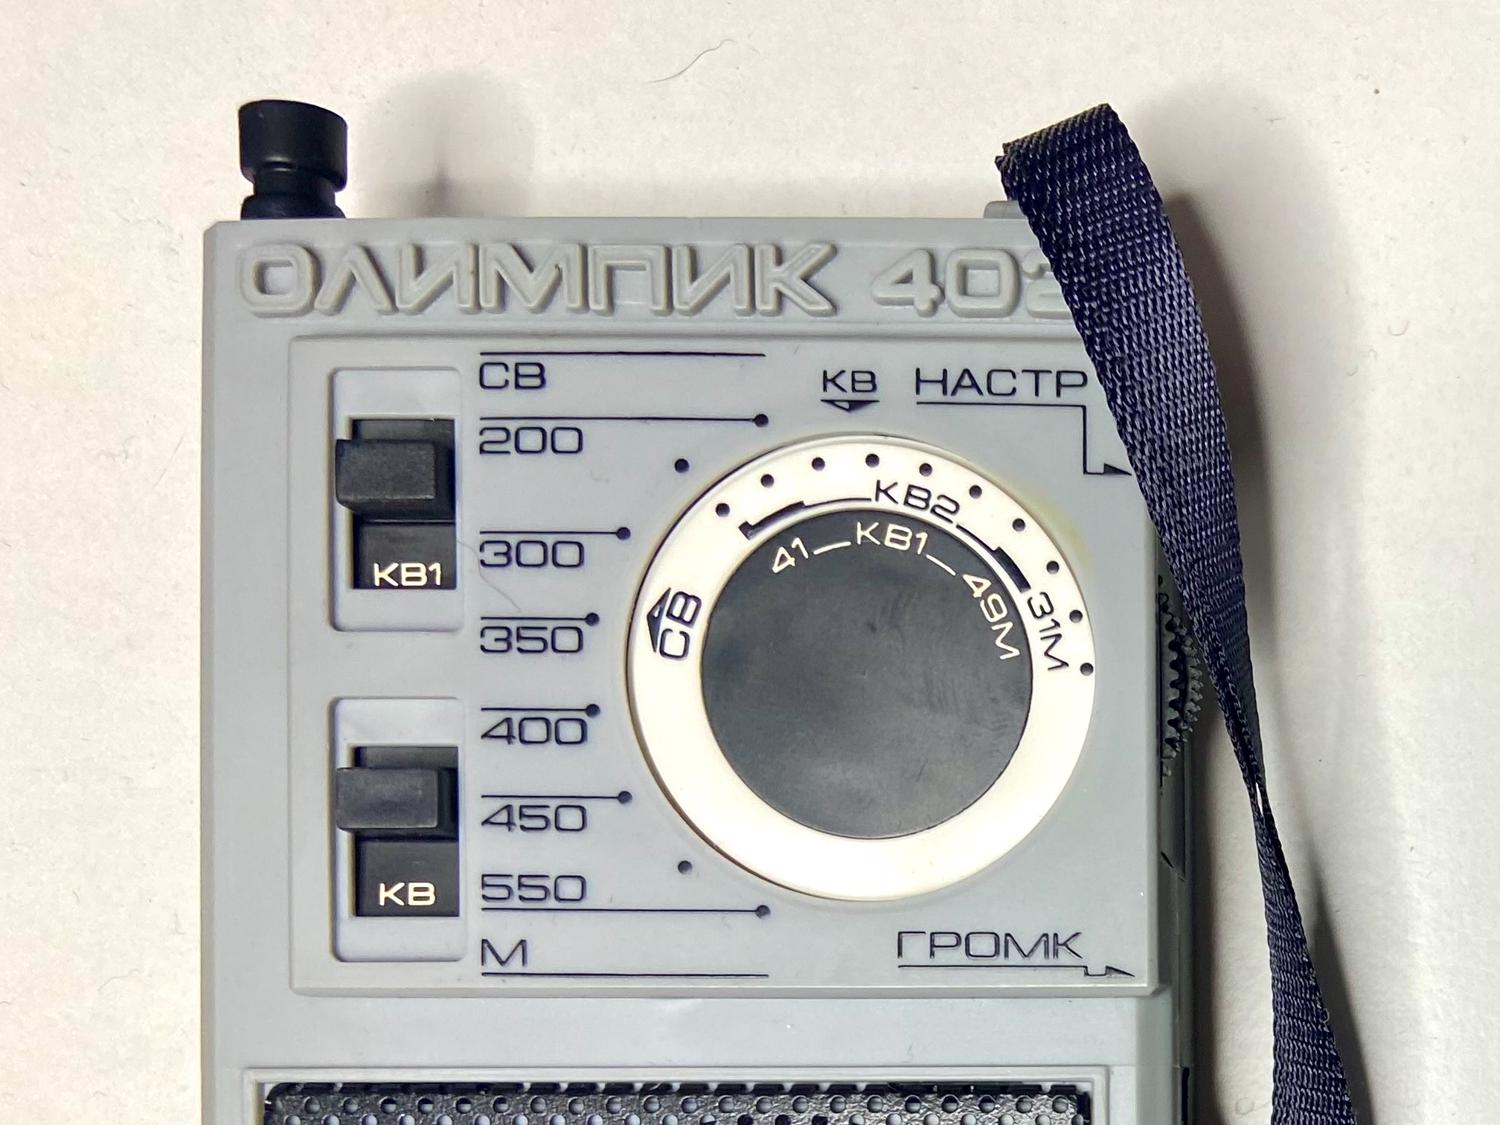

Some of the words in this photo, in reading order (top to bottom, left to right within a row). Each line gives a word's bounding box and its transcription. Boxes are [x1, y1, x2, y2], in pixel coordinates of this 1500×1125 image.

[240, 240, 838, 318] ОЛИМПИК
[479, 362, 547, 391] СВ
[822, 370, 878, 394] КВ
[915, 368, 1089, 398] НАСТР
[479, 427, 583, 455] 200
[480, 540, 584, 568] 300
[772, 537, 809, 574] 41
[480, 626, 584, 654] 350
[481, 717, 587, 745] 400
[481, 804, 587, 832] 450
[481, 874, 587, 902] 550
[481, 938, 527, 967] М
[897, 931, 1083, 959] ГРОМК
